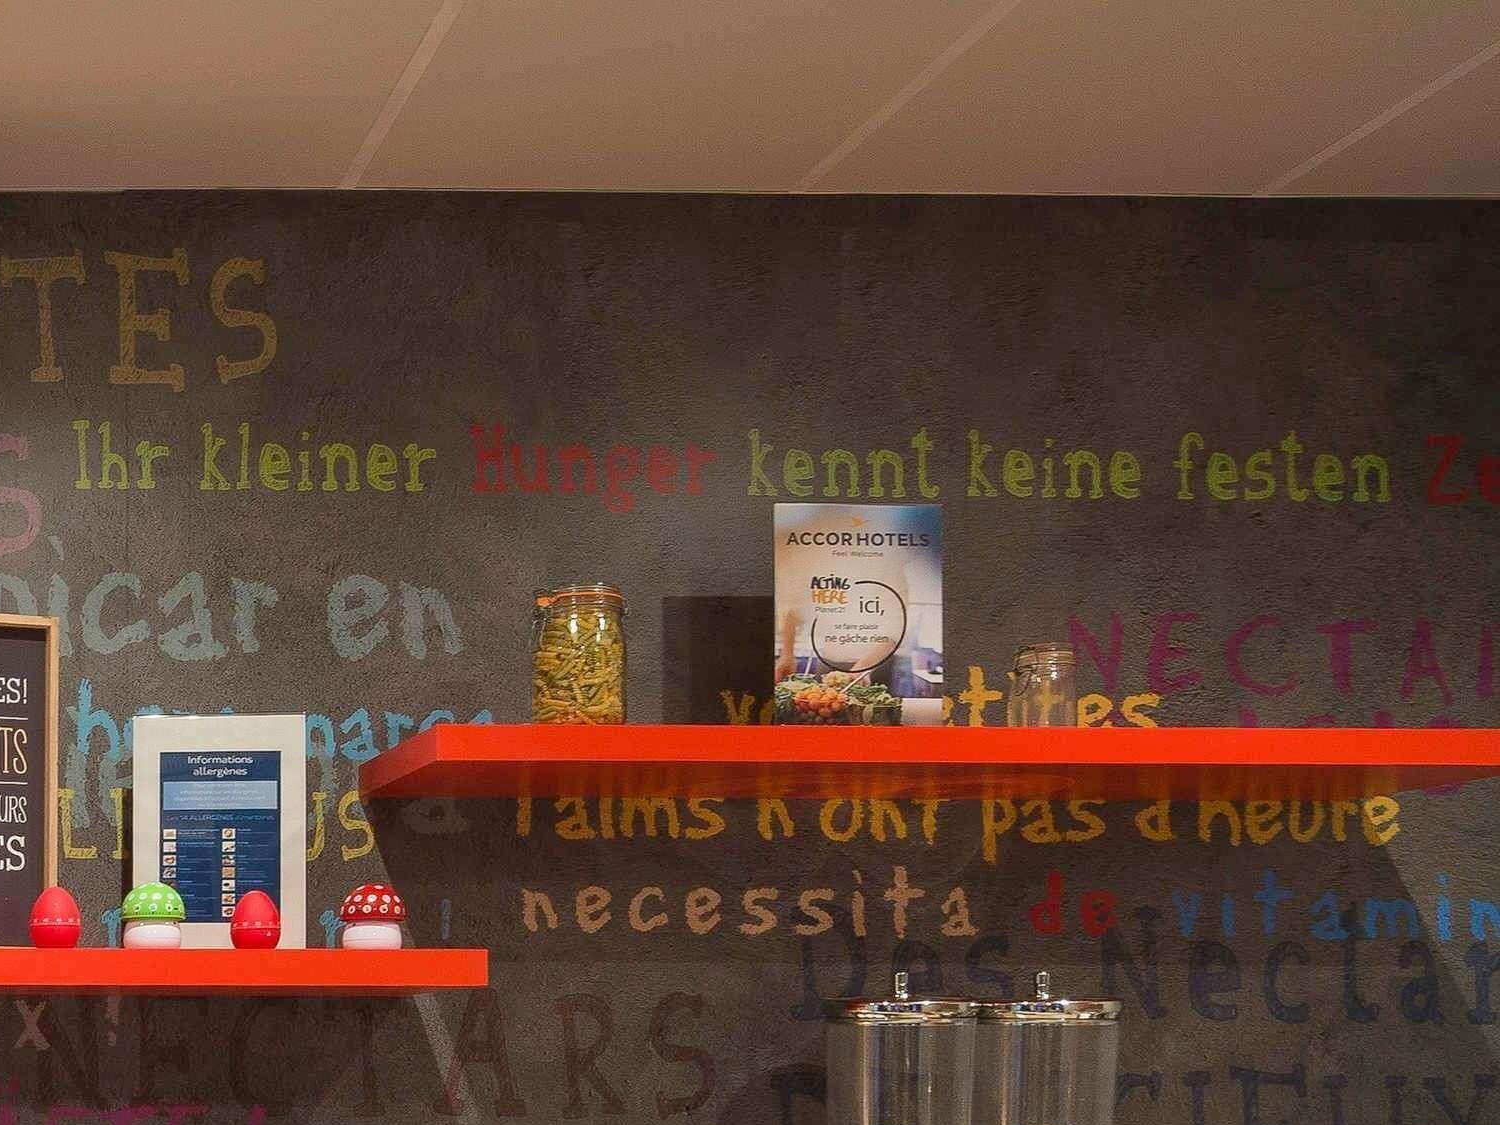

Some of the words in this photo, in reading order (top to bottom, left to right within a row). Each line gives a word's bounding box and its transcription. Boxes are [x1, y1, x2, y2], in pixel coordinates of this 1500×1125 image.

[72, 418, 169, 491] Ihr
[200, 420, 436, 493] kleiner
[467, 422, 717, 514] Hunger
[747, 428, 940, 499] kennt
[966, 428, 1143, 499] keine
[1173, 431, 1391, 502] festen
[787, 532, 853, 546] ACCOR
[857, 532, 930, 547] HOTELS
[812, 590, 848, 604] HERE
[859, 596, 885, 616] ici,
[325, 571, 466, 663] en
[825, 635, 838, 643] ne
[840, 633, 868, 645] gâche
[870, 634, 890, 643] rien
[187, 754, 254, 764] Informations
[192, 767, 248, 777] allergènes
[1028, 871, 1117, 936] de
